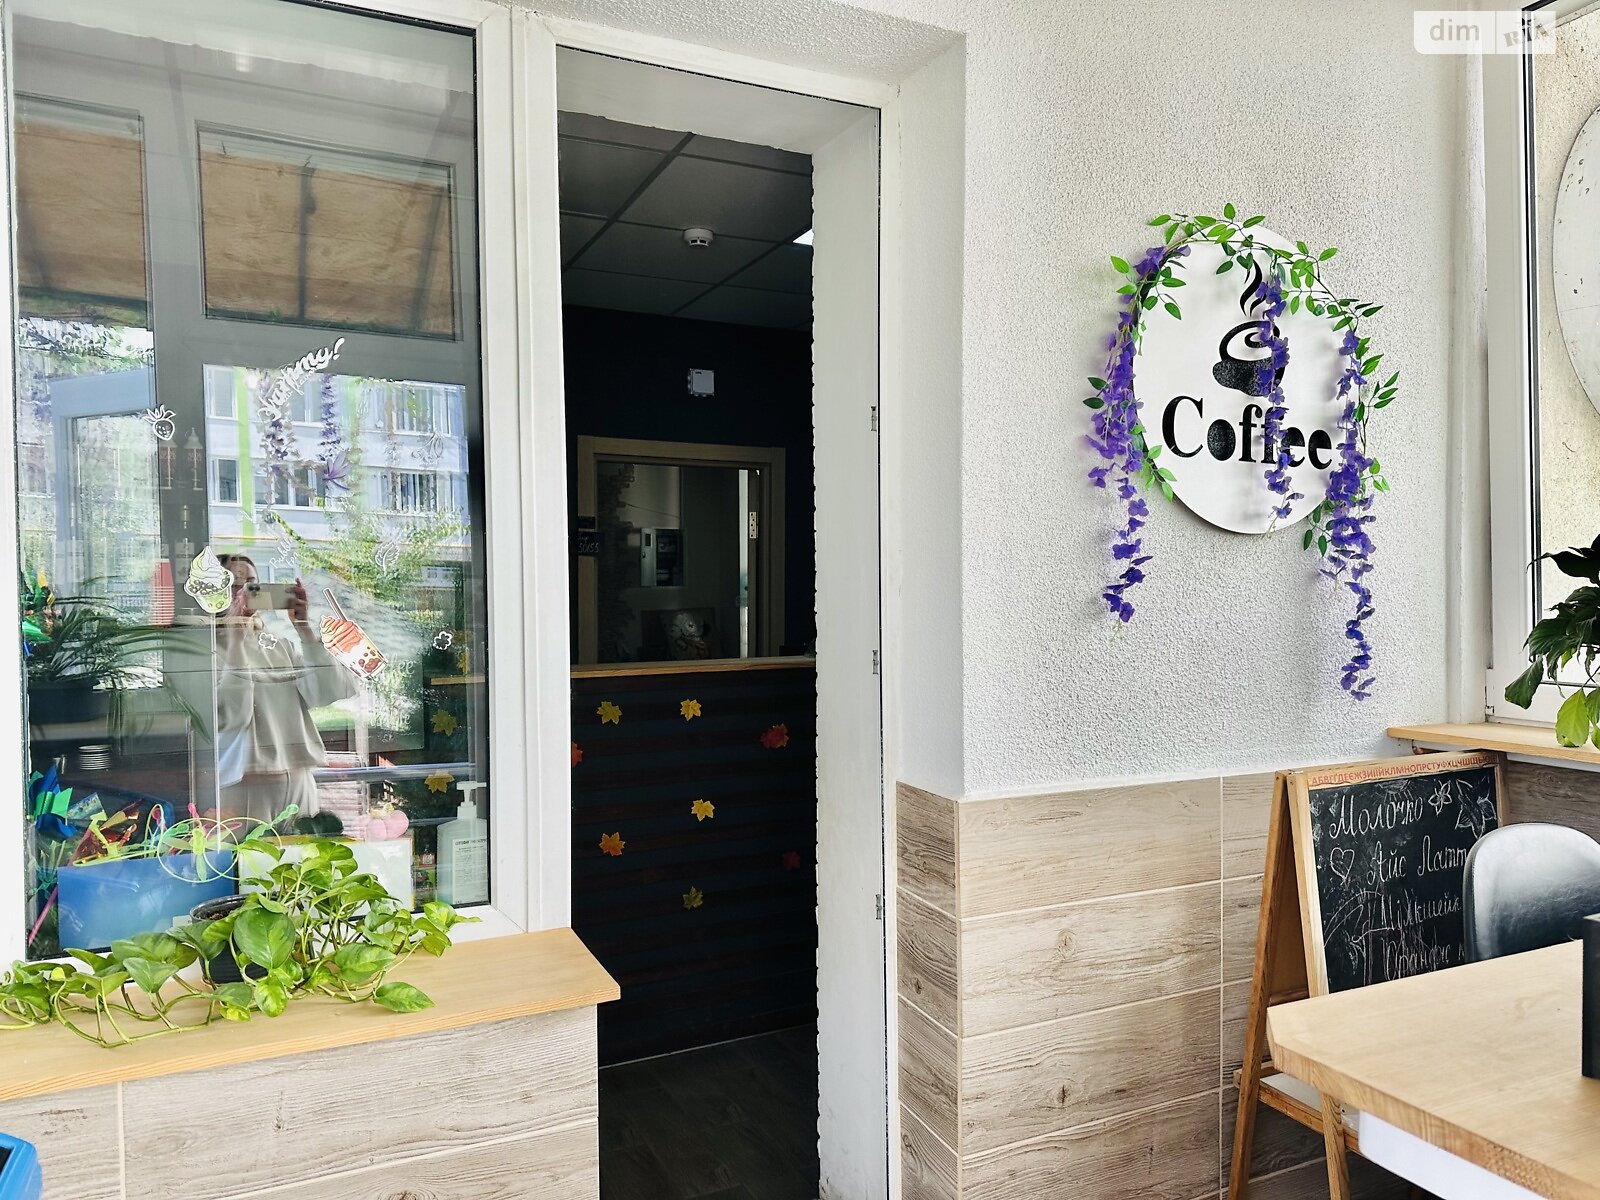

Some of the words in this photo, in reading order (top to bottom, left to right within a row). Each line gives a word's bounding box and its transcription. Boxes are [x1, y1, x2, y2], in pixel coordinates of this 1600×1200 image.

[1161, 395, 1333, 470] Coffee
[1329, 794, 1424, 839] Молочко
[1366, 840, 1407, 886] Айс
[1416, 834, 1467, 877] Латт
